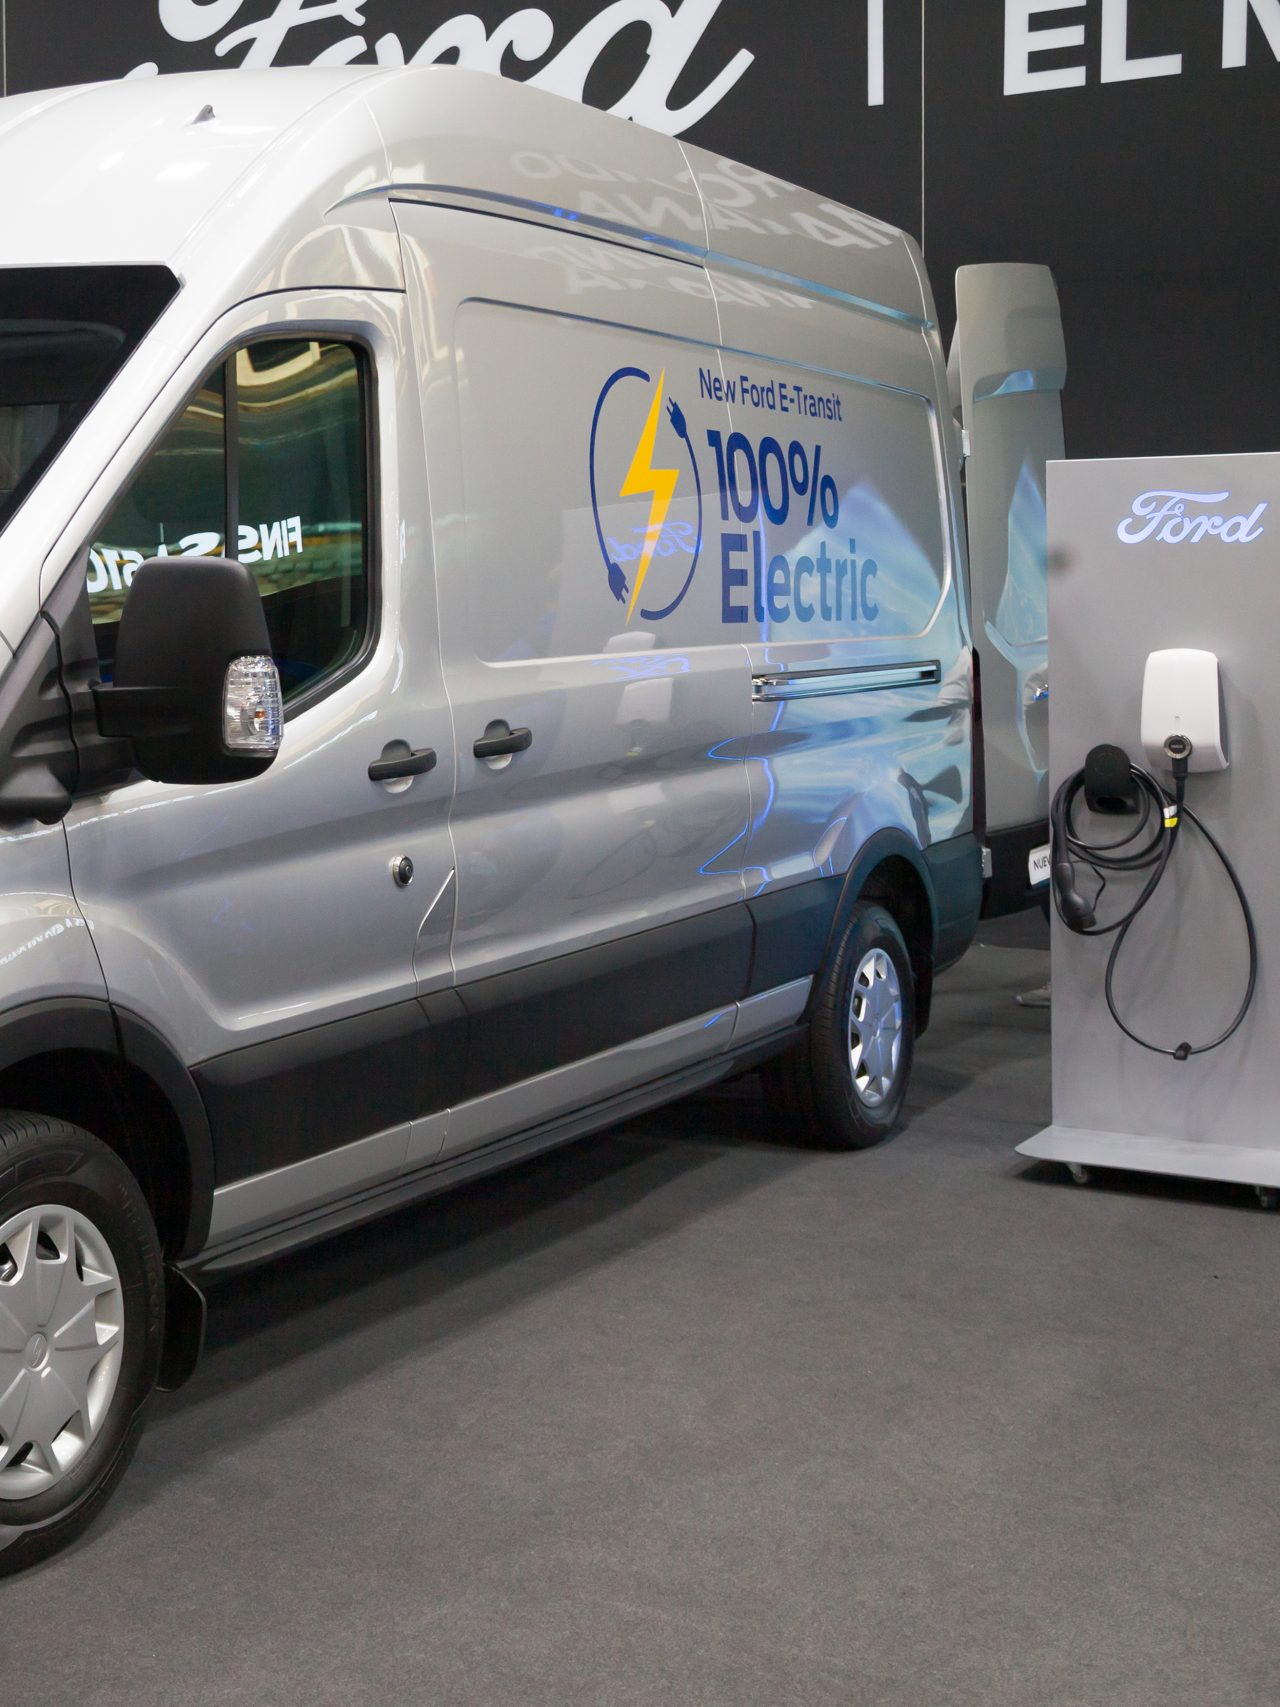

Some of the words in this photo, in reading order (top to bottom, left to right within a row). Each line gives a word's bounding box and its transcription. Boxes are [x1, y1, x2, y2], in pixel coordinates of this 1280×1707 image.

[1004, 0, 1183, 96] EL
[699, 367, 736, 402] New
[740, 375, 775, 411] Ford
[779, 382, 843, 422] E-Transit
[706, 429, 839, 529] 100%
[1116, 489, 1268, 544] Ford
[720, 530, 880, 624] Electric
